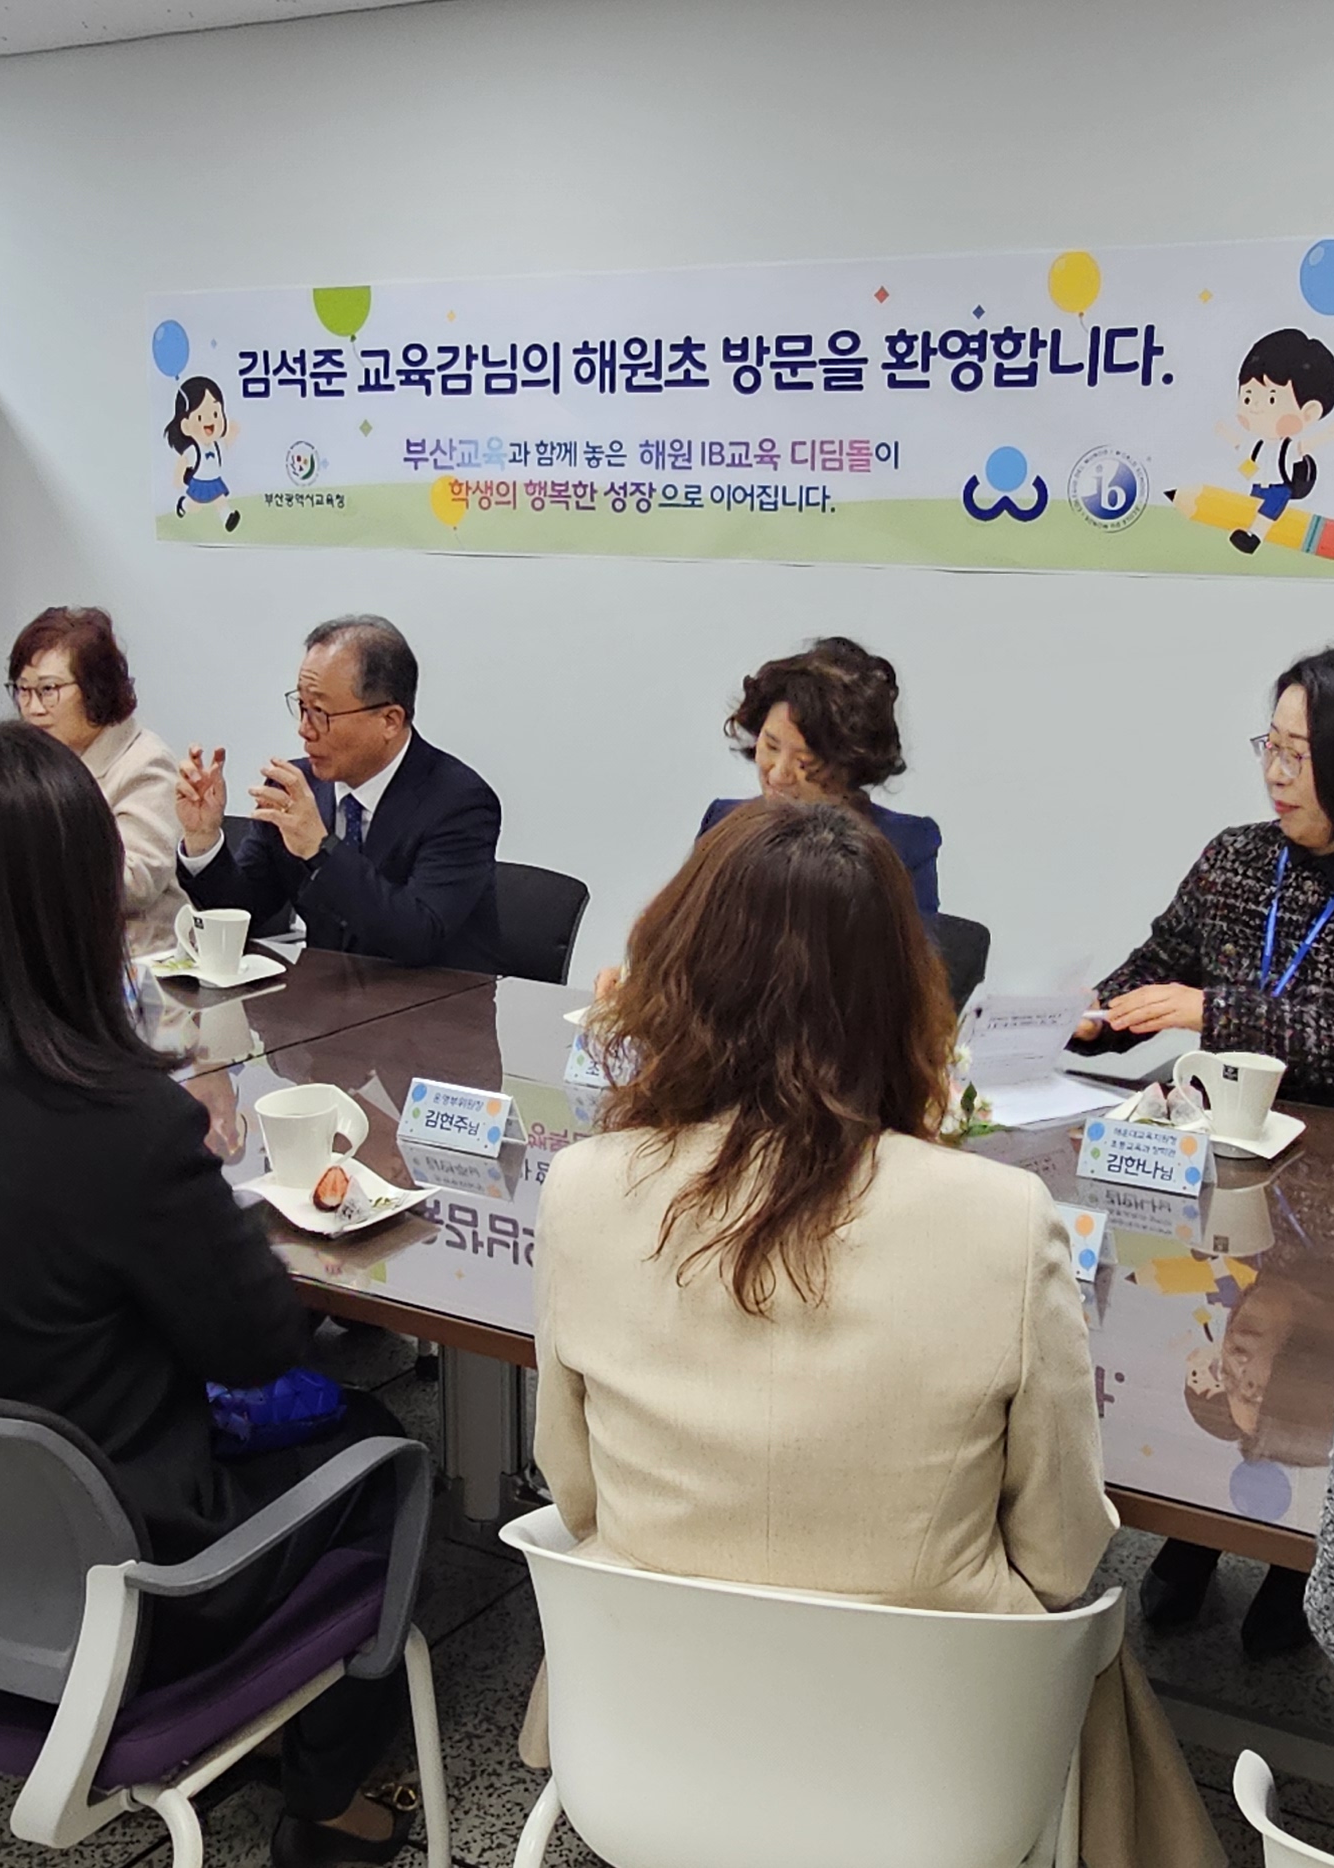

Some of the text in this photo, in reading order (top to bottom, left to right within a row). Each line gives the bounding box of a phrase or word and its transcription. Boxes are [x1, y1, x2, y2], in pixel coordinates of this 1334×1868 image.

[237, 324, 1174, 398] 김석준 교육감님의 해원초 방문을 환영합니다.
[403, 436, 899, 473] 부산교육과 함께 놓은 해원 IB교육 디딤돌이
[264, 493, 345, 509] 부산광역시교육청
[448, 478, 517, 511] 학생의
[523, 479, 598, 511] 행복한
[710, 484, 836, 514] 이어집니다.
[424, 1109, 481, 1136] 김현주님
[1106, 1153, 1174, 1181] 김한나님
